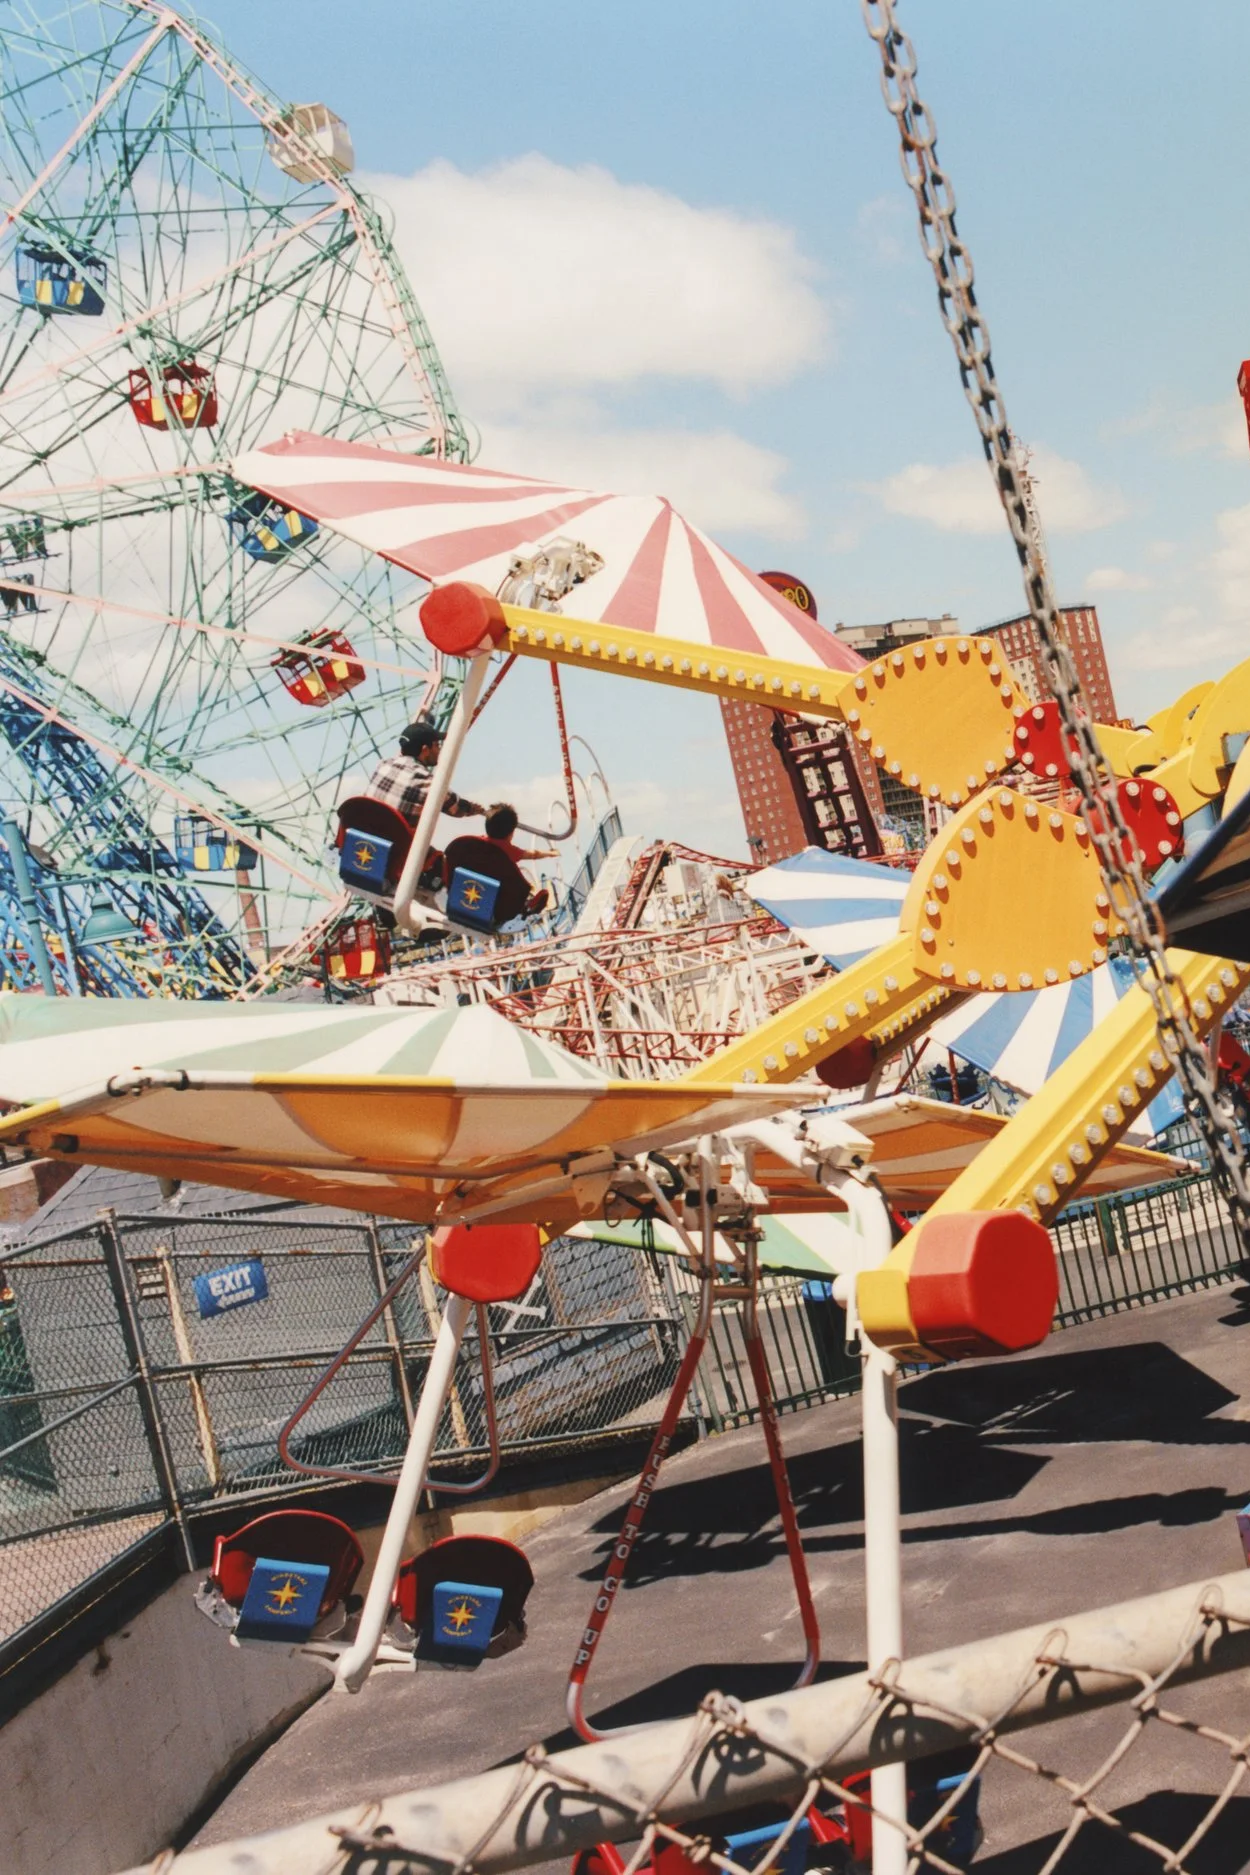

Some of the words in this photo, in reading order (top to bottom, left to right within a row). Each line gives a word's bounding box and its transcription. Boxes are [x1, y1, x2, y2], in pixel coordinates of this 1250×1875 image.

[208, 1265, 252, 1297] EXIT
[635, 1435, 670, 1508] PUSH
[616, 1524, 638, 1559] TO
[596, 1576, 617, 1613] GO
[575, 1629, 599, 1666] UP
